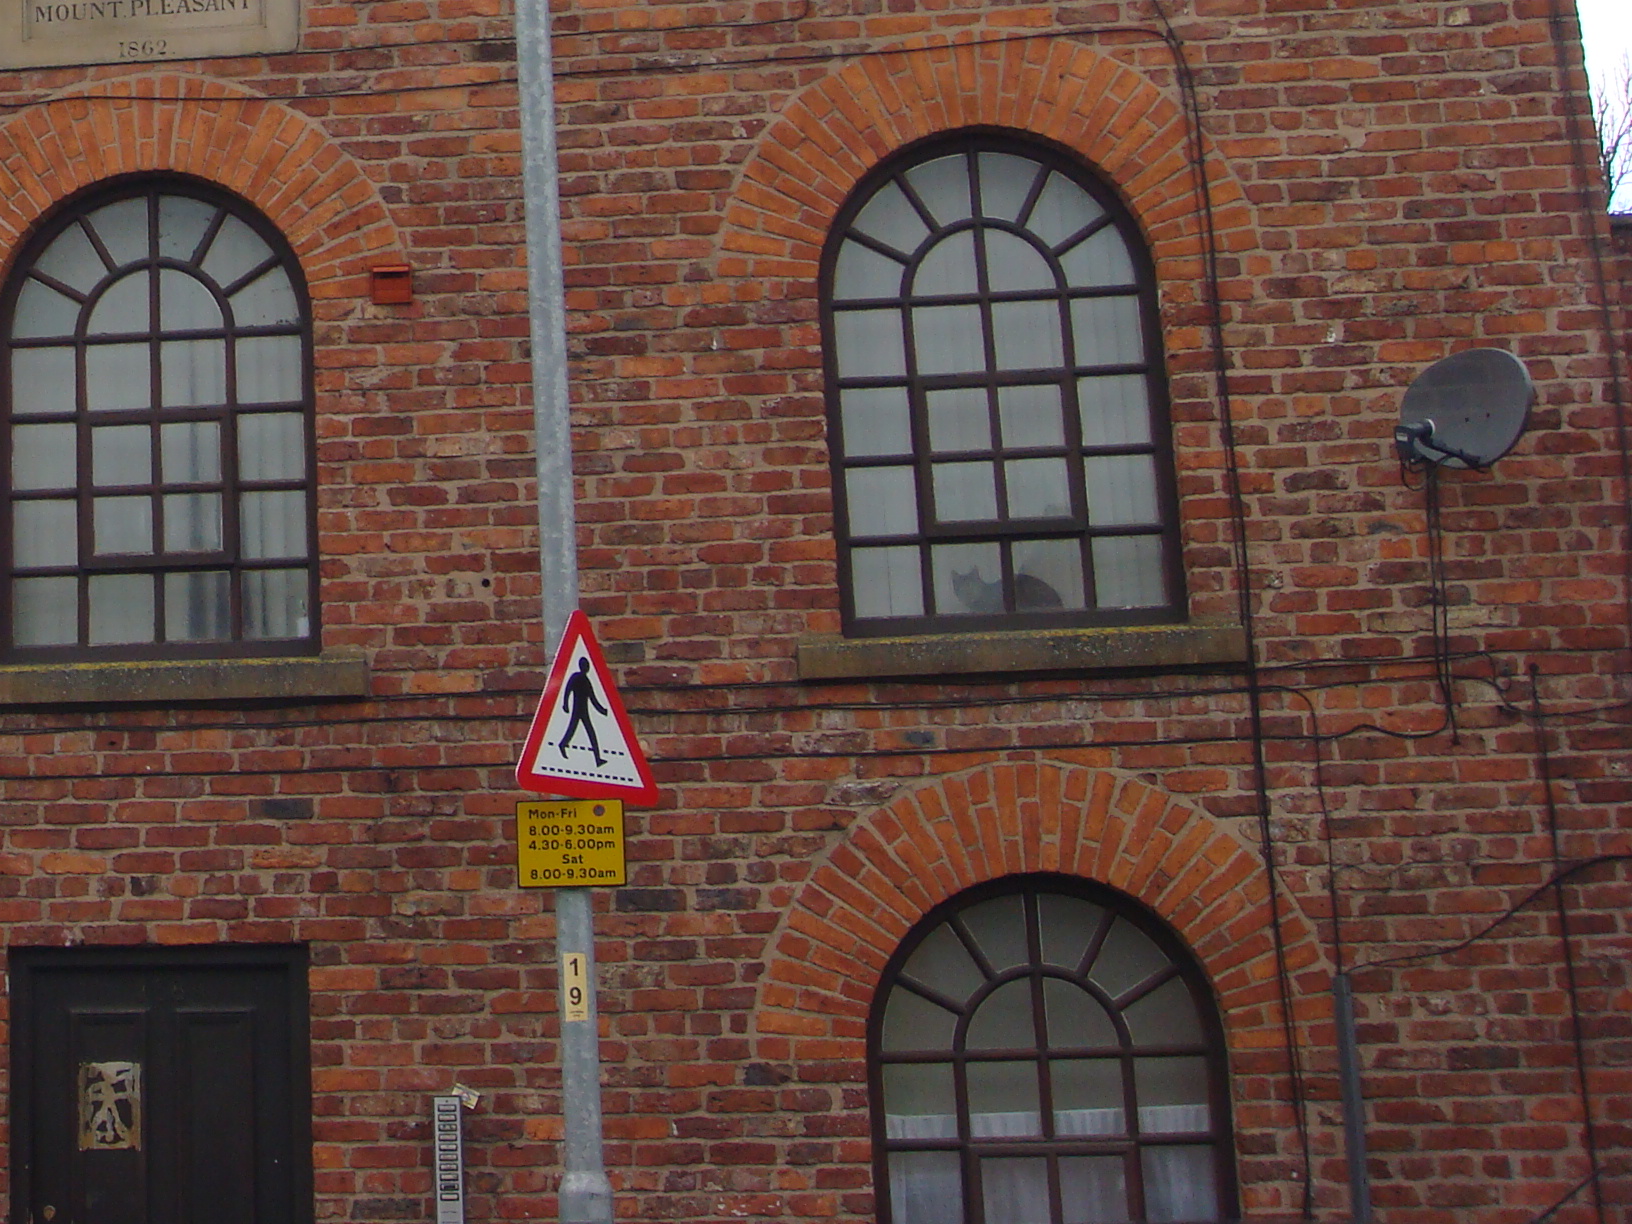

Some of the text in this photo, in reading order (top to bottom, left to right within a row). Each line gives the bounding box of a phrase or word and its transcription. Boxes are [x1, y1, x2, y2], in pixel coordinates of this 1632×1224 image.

[528, 808, 577, 819] Mon-Fri
[528, 824, 615, 836] 8.00-9.30am
[528, 839, 616, 851] 4.30-6.00pm
[561, 853, 584, 865] Sat
[530, 868, 617, 880] 8.00-9.30am
